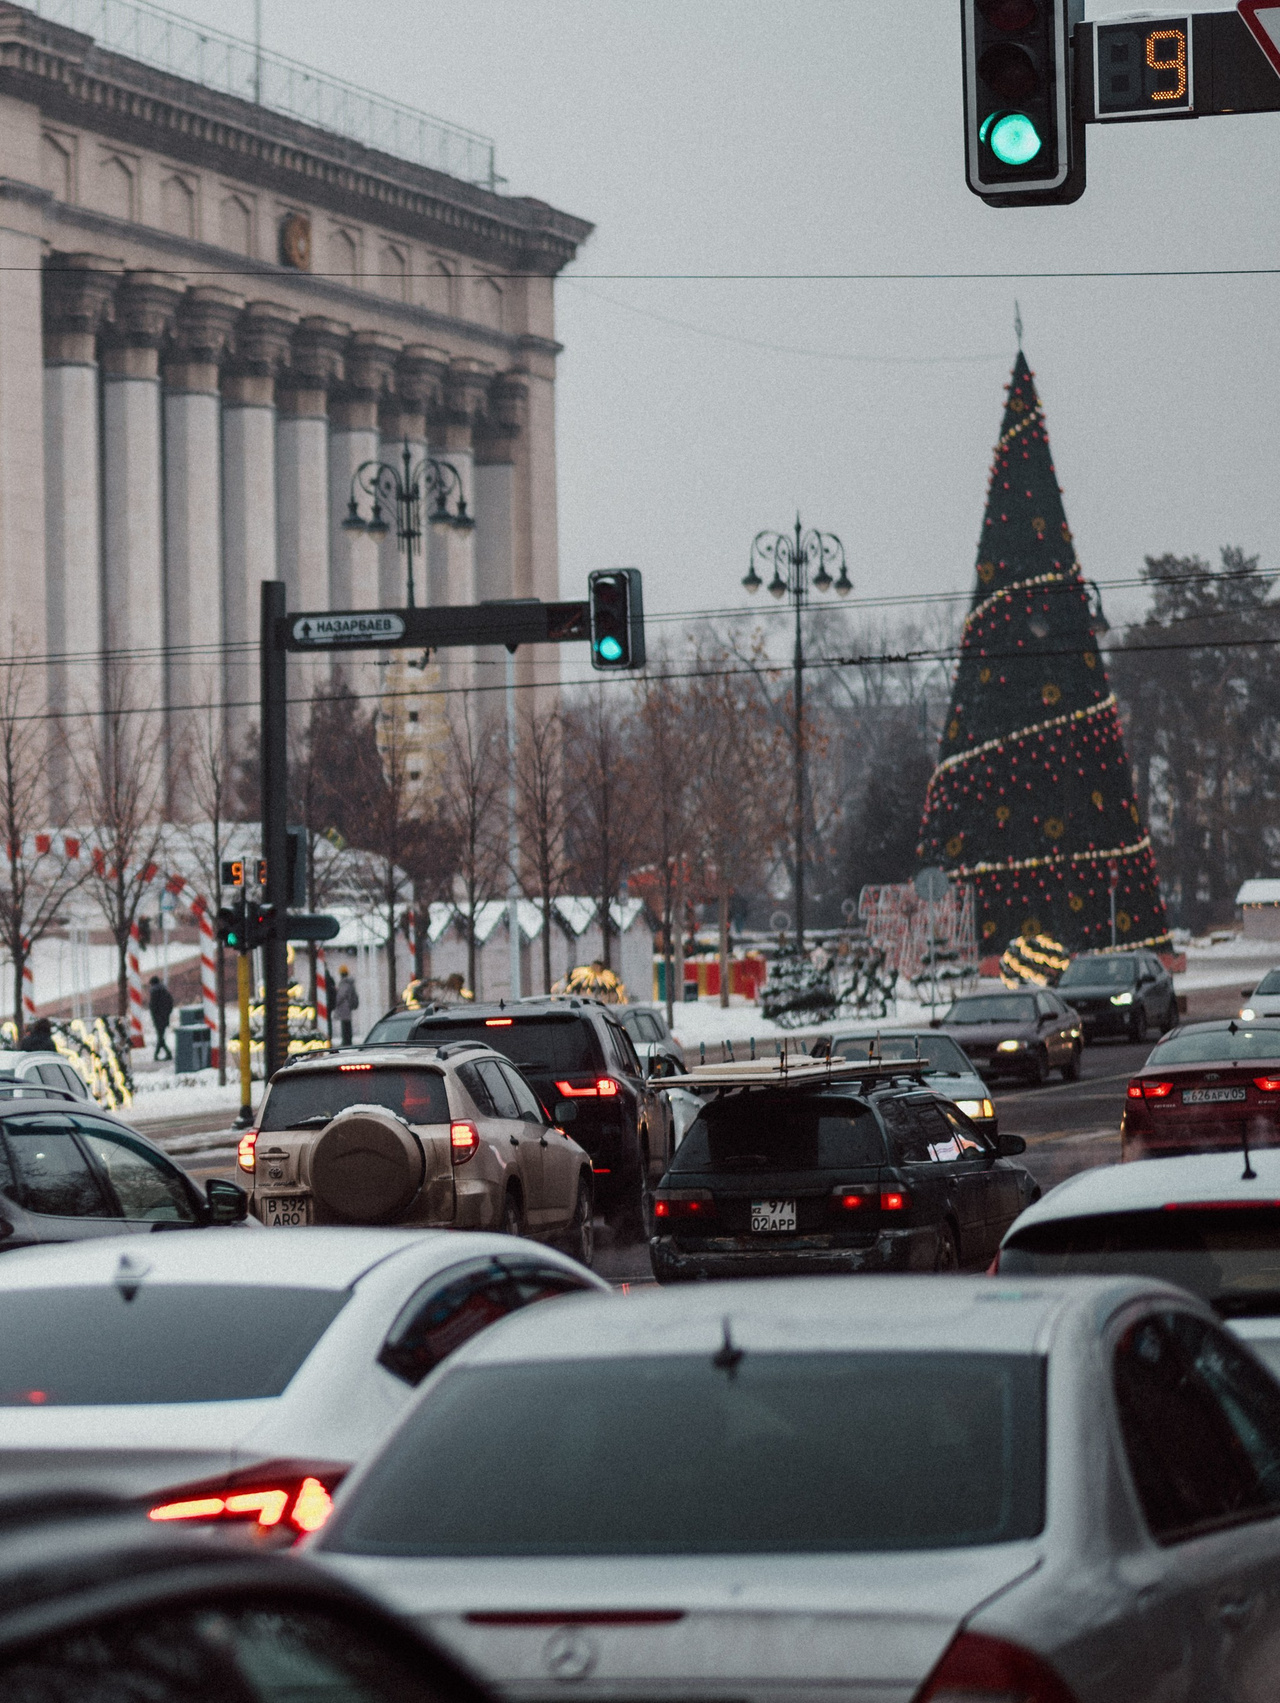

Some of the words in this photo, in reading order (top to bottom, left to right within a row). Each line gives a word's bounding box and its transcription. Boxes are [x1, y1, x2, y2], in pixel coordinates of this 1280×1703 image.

[1146, 30, 1186, 100] 9
[317, 618, 392, 633] НАЗАРБАЕВ
[231, 862, 243, 885] 9
[768, 1200, 795, 1214] 971
[273, 1212, 301, 1226] ARO
